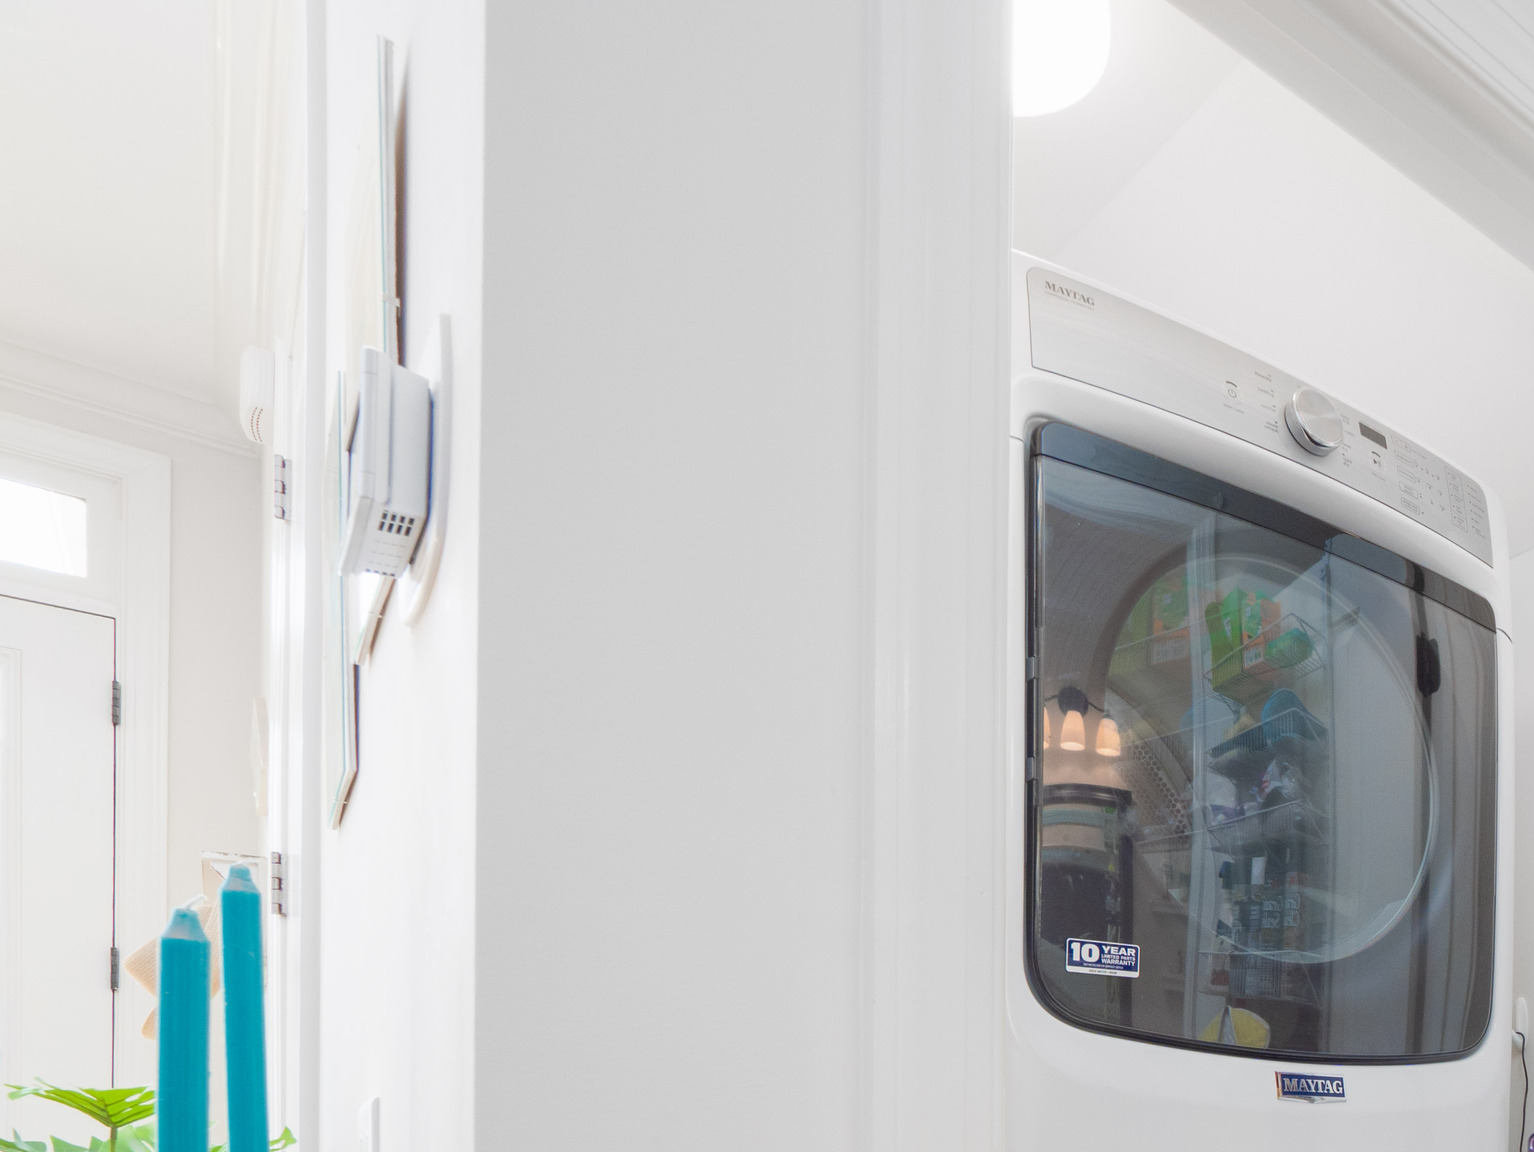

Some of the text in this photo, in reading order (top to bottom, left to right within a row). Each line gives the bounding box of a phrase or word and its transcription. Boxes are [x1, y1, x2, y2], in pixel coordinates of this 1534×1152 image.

[1045, 280, 1095, 307] MAYTAG
[1071, 942, 1100, 963] 10
[1102, 945, 1136, 957] YEAR
[1101, 959, 1136, 967] WARRANTY
[1282, 1076, 1344, 1095] MAYTAG
